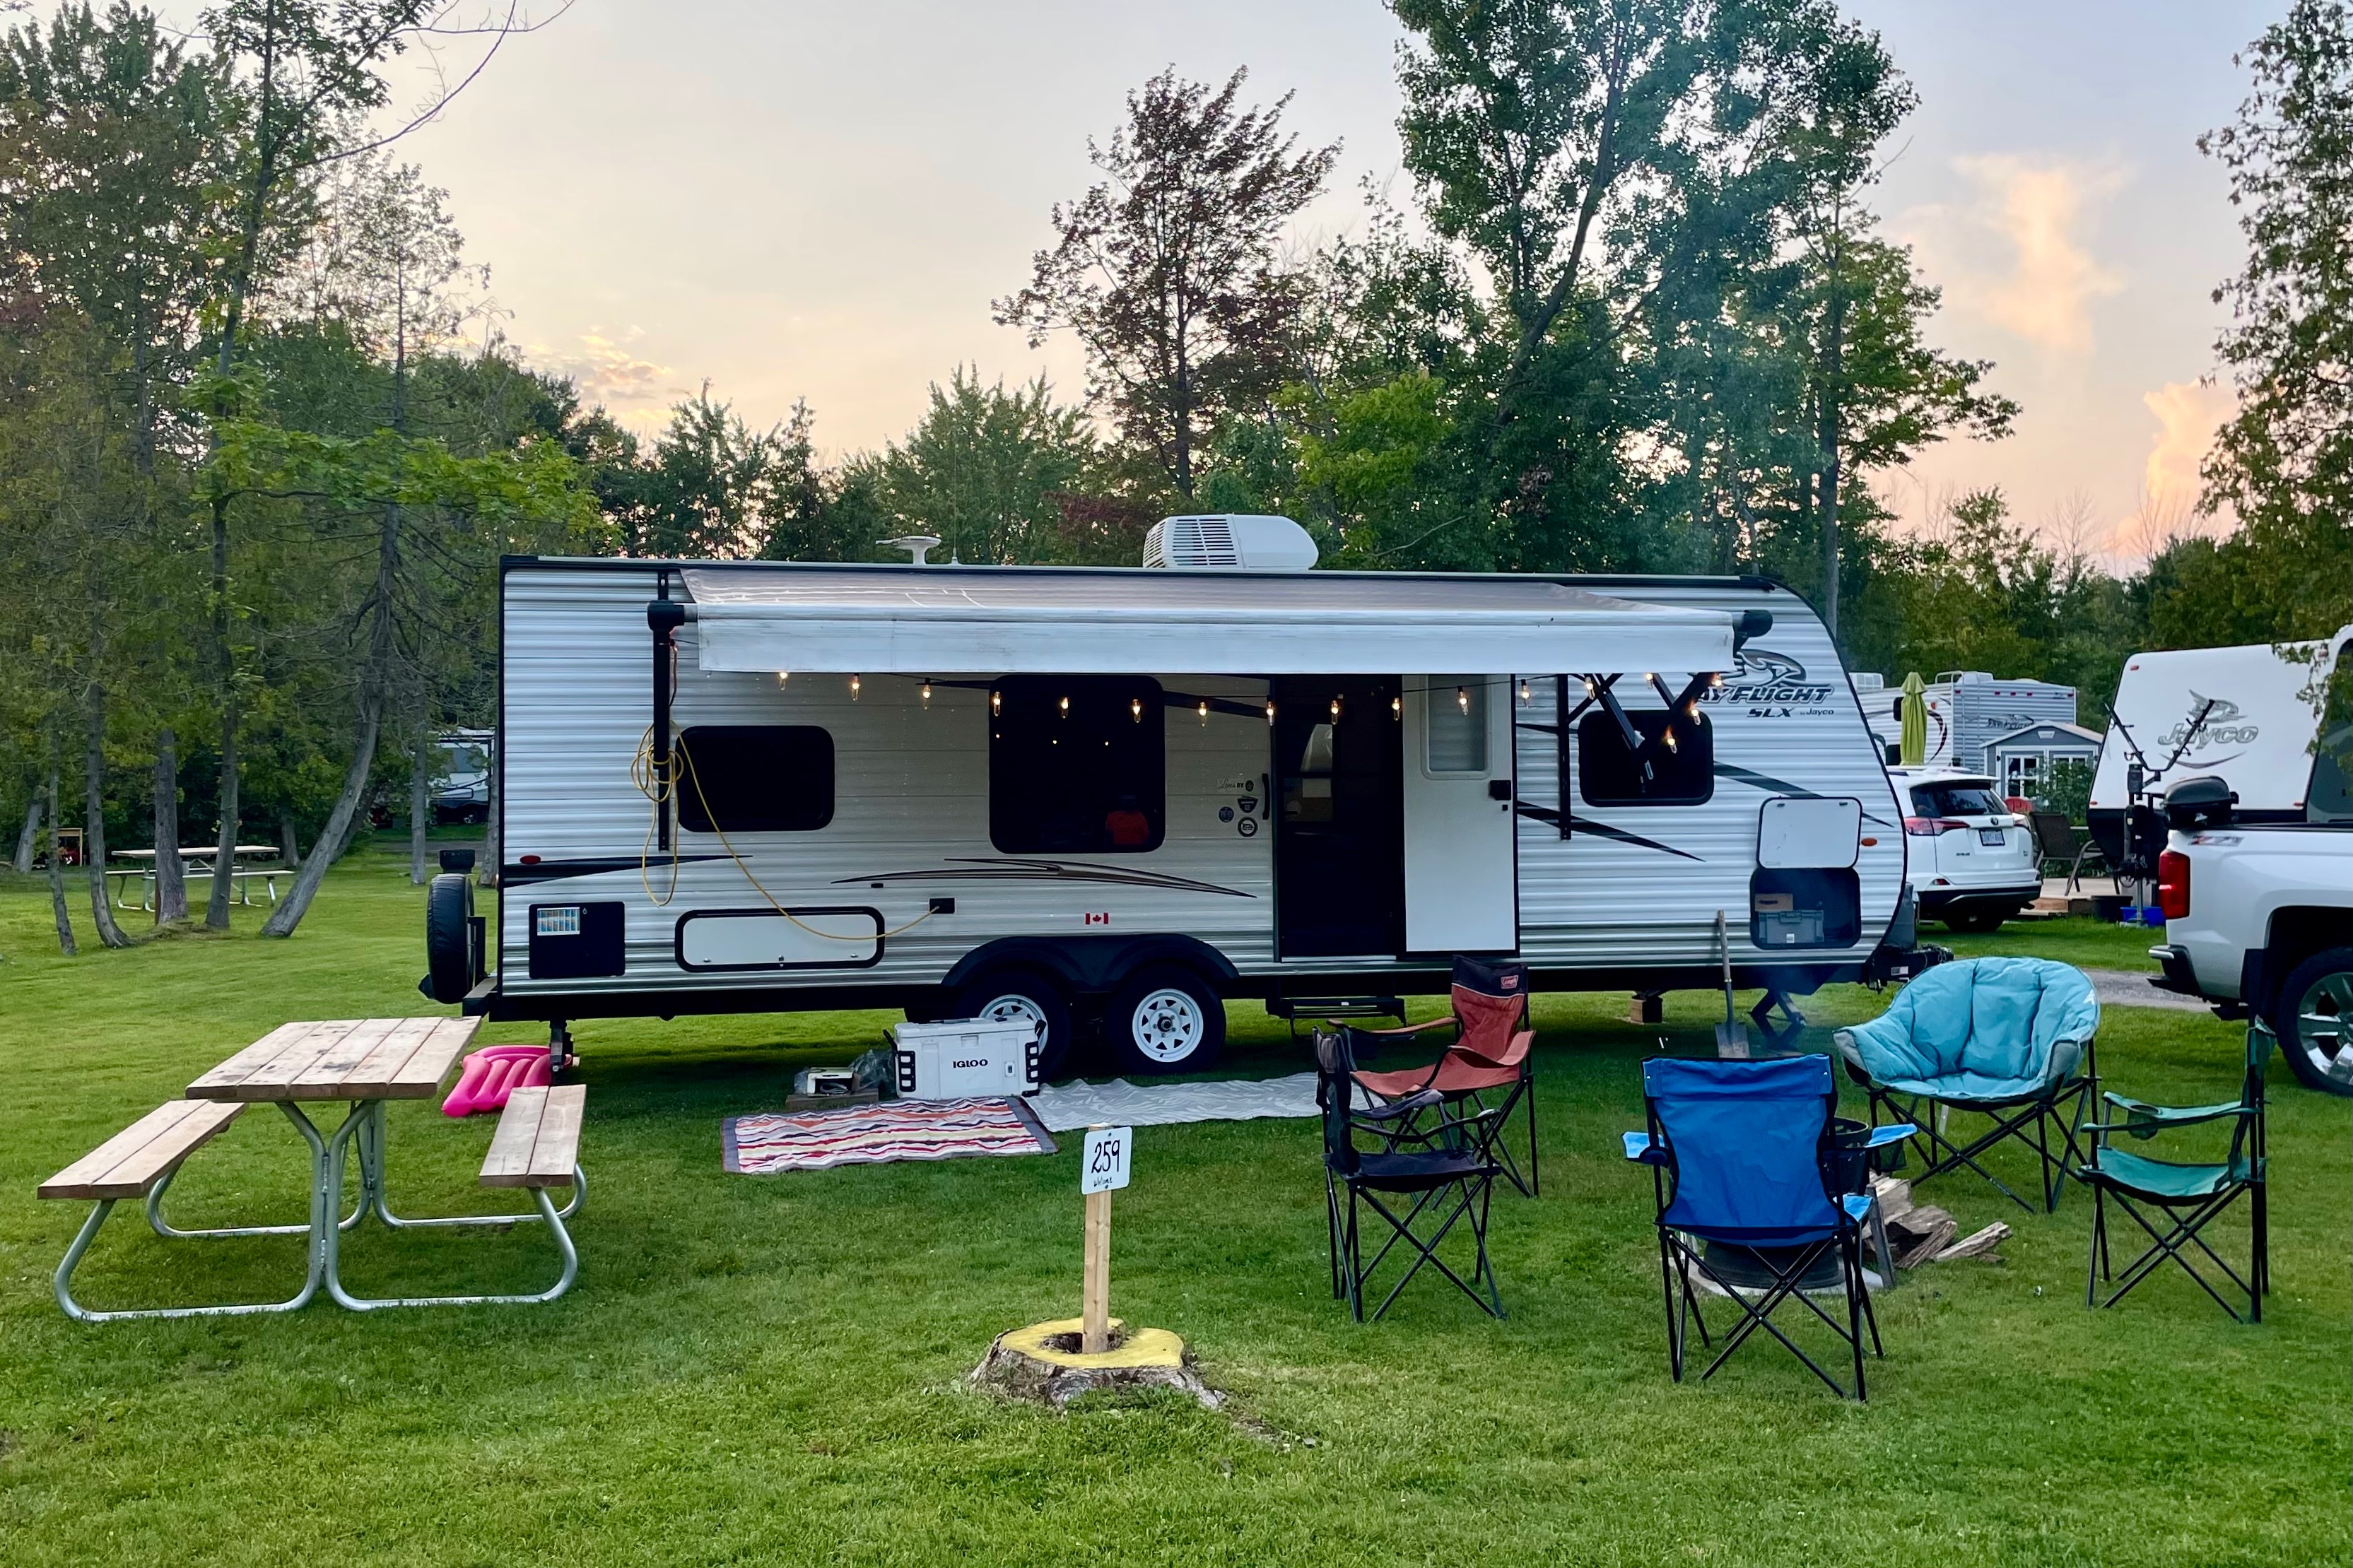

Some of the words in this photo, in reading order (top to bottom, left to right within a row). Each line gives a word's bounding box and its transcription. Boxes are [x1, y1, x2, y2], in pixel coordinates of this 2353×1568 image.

[1727, 685, 1834, 703] FLIGHT
[1747, 707, 1795, 717] SLX
[2157, 722, 2259, 750] Jayco
[953, 1059, 988, 1069] IGLOO
[1091, 1139, 1120, 1174] 259
